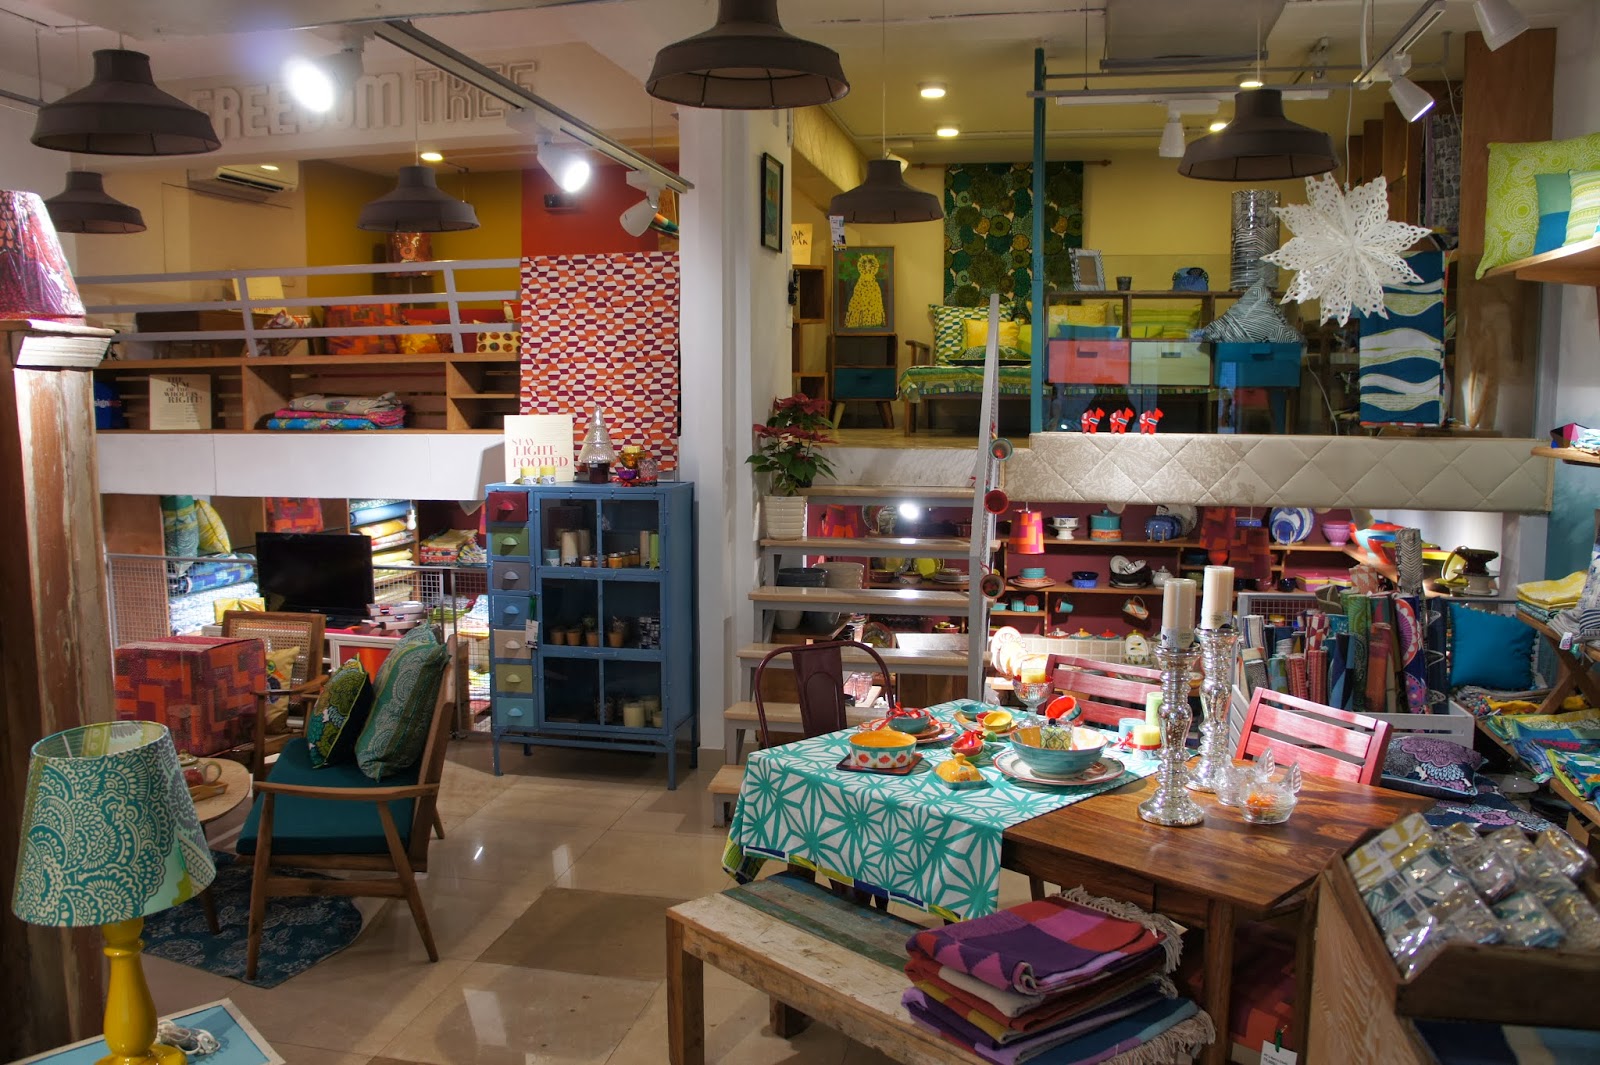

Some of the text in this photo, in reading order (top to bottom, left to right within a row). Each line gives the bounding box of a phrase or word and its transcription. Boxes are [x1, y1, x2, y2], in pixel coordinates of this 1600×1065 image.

[190, 72, 400, 141] FREEOM
[512, 438, 534, 446] STAY
[516, 445, 558, 456] LIGHT-
[513, 456, 569, 468] FOOTED
